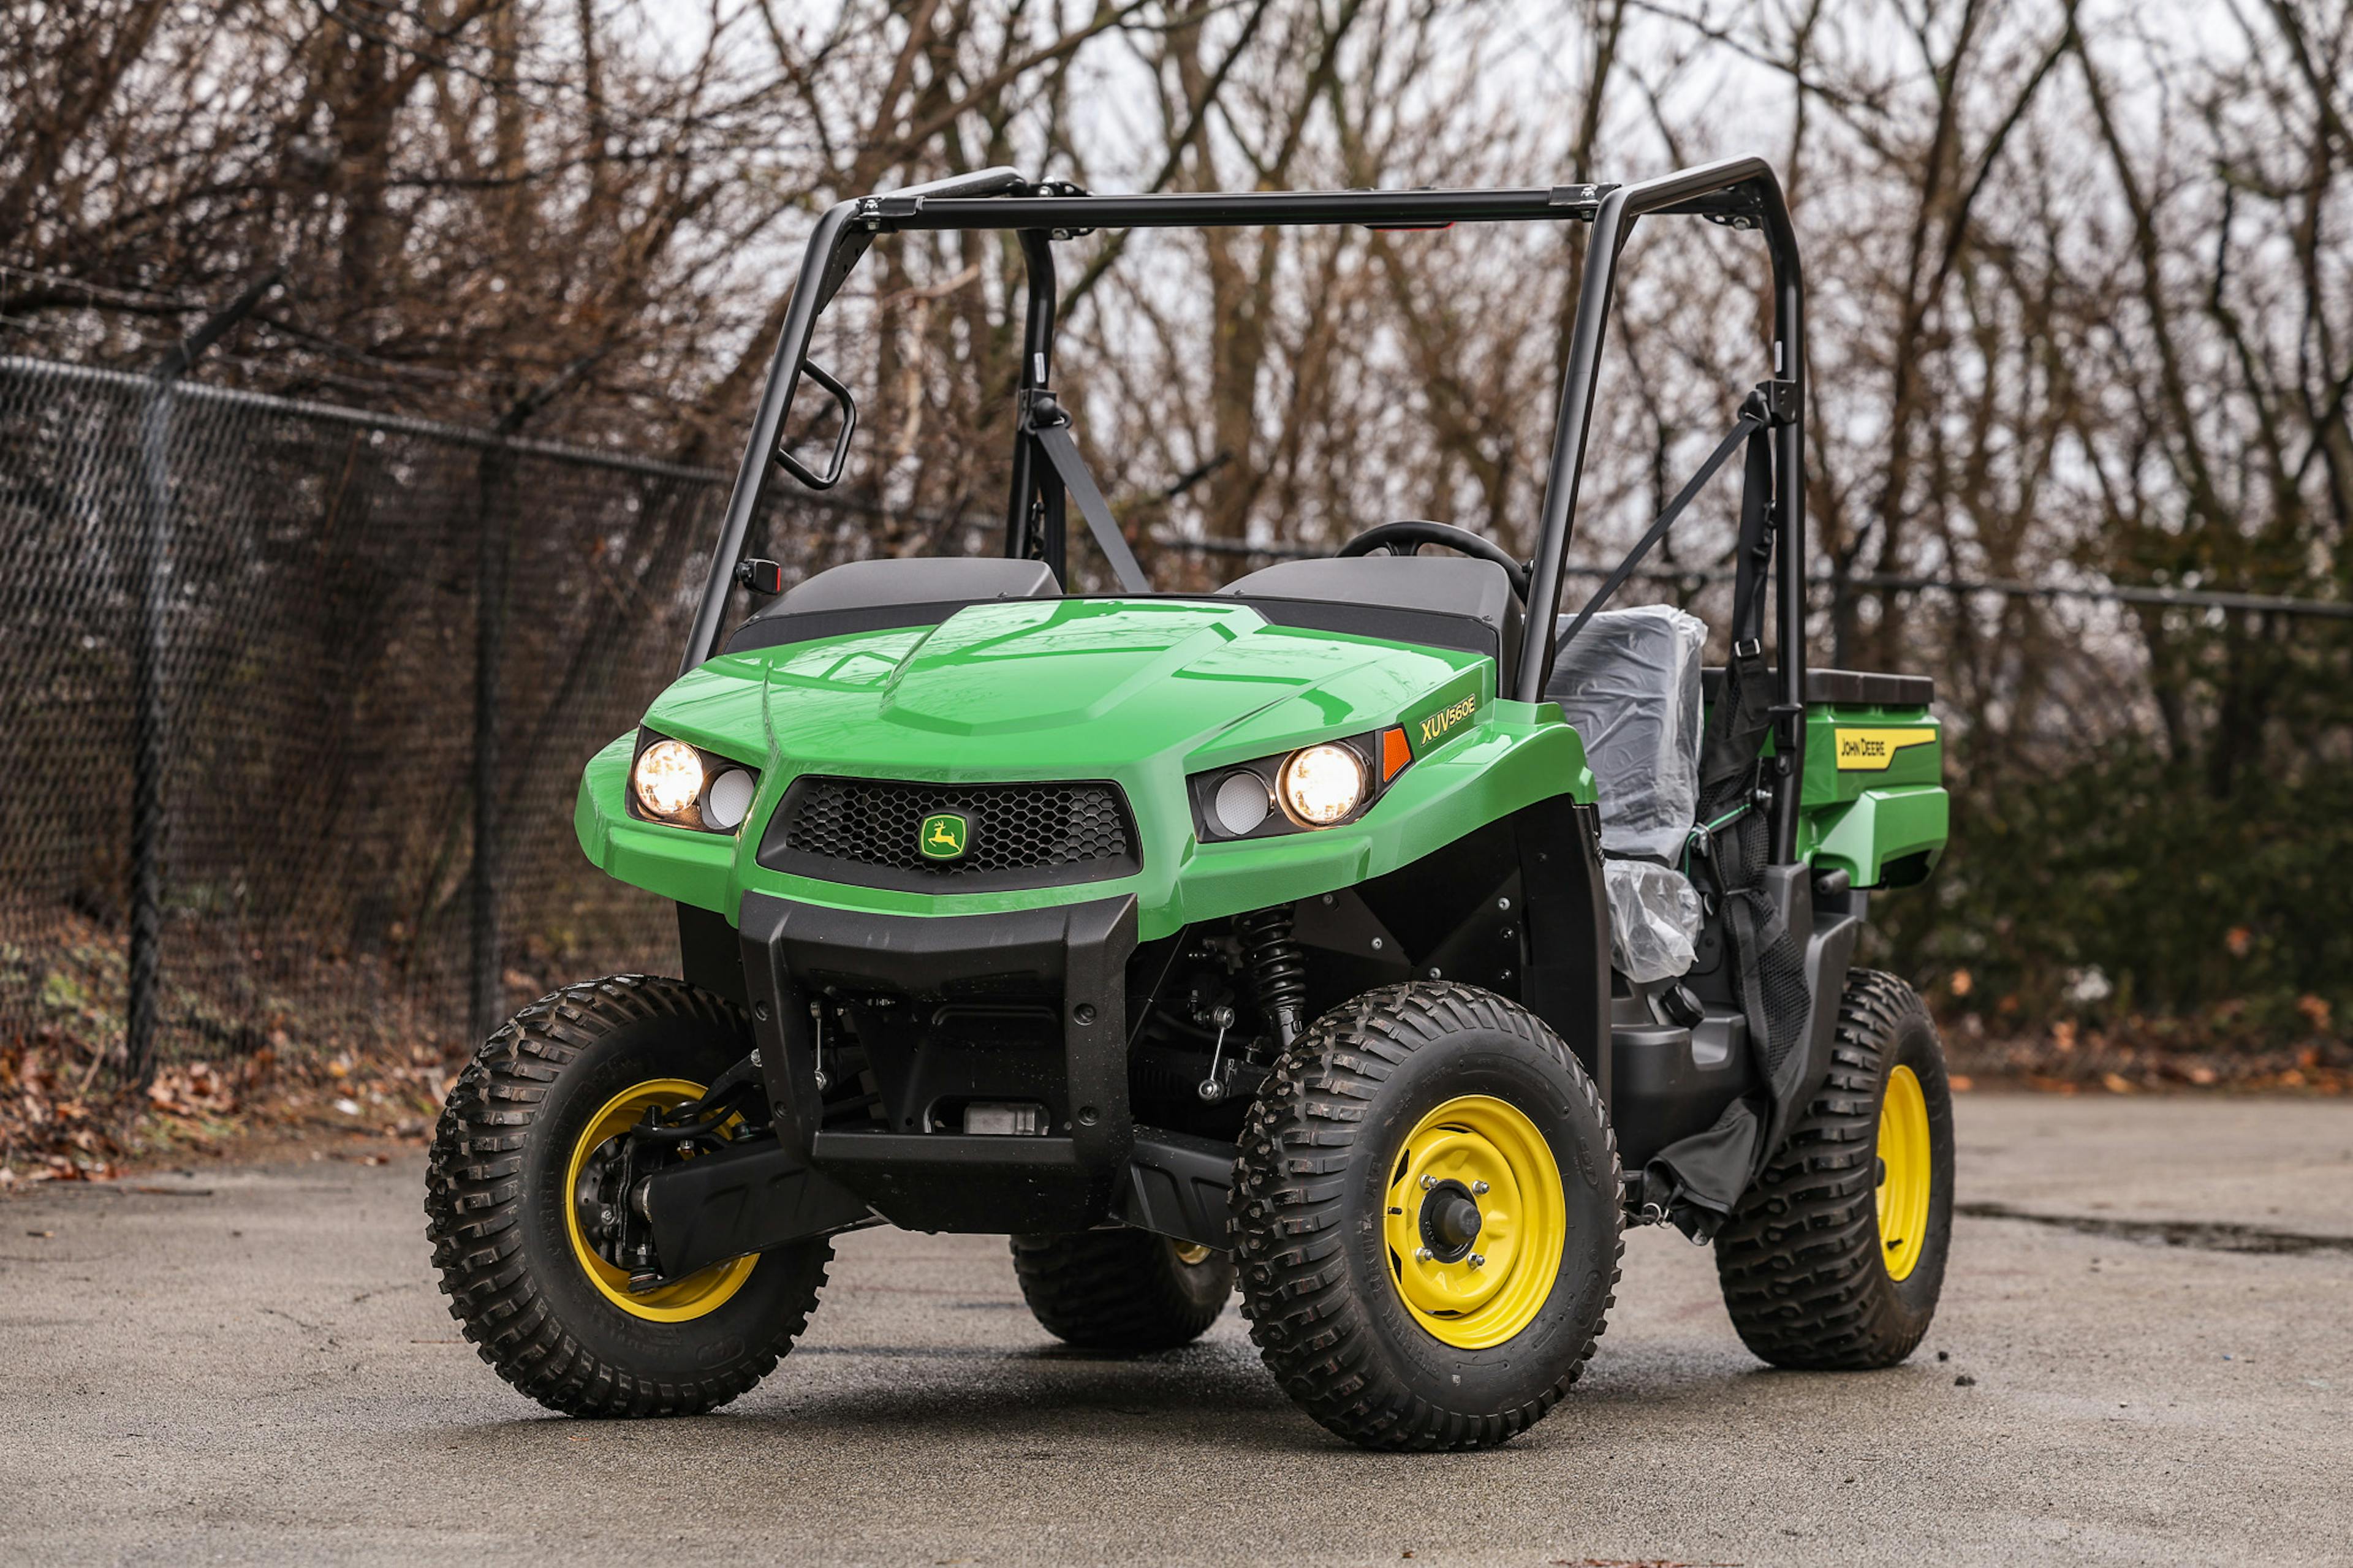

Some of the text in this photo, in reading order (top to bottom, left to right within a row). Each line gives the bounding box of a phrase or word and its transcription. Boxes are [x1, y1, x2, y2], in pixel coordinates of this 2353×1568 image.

[1420, 695, 1476, 746] XUV560E
[1841, 738, 1885, 756] JOHN DEERE
